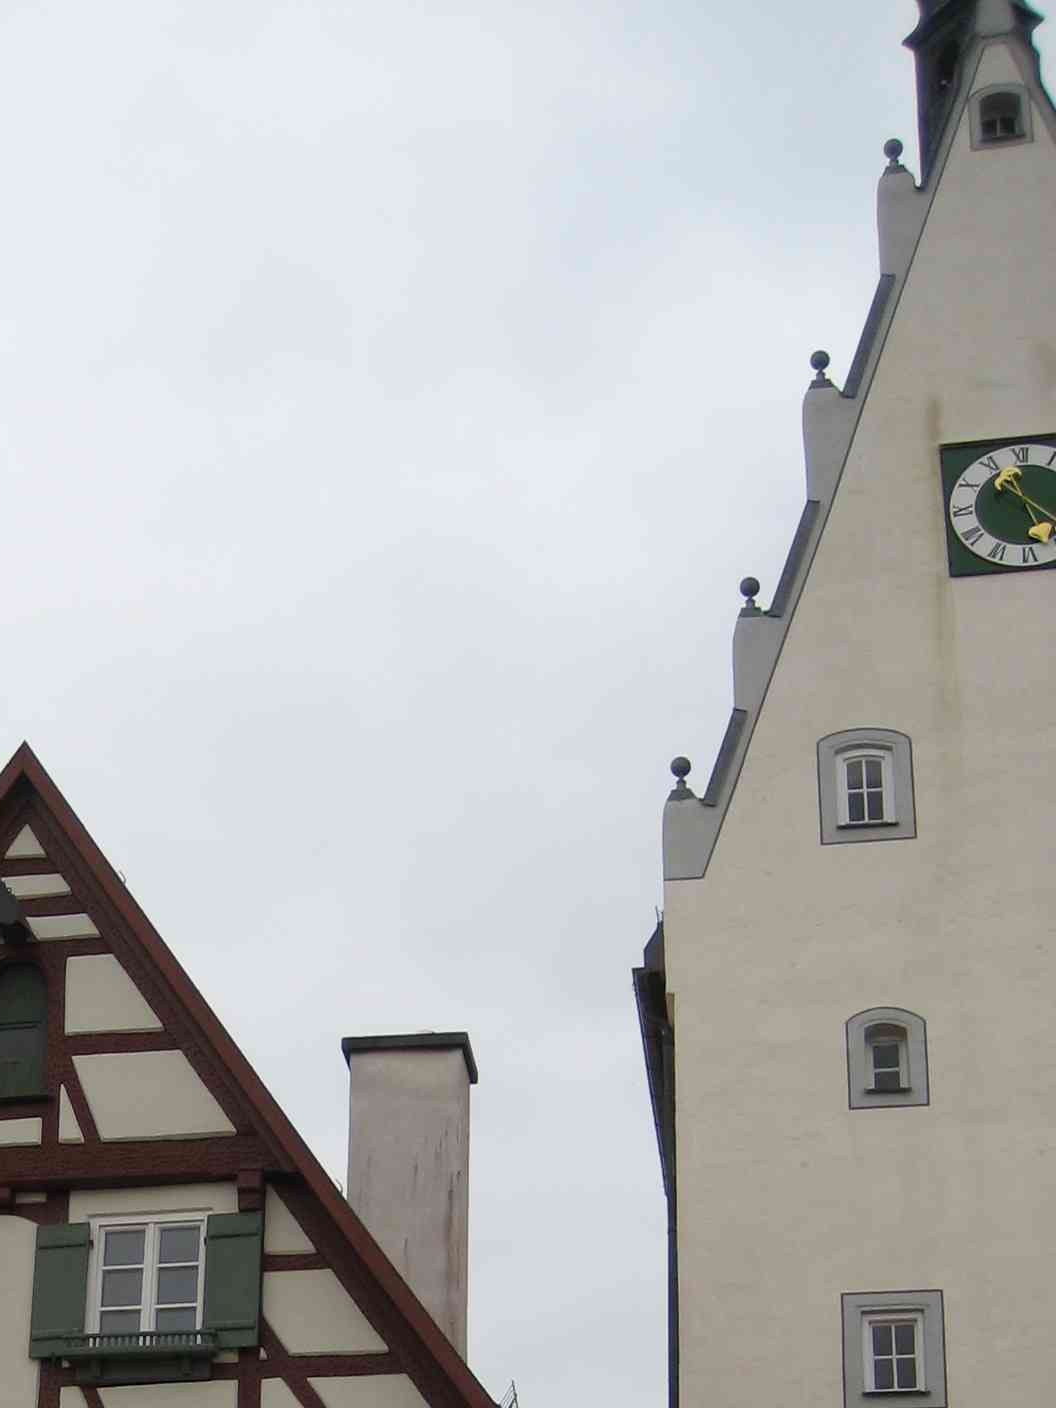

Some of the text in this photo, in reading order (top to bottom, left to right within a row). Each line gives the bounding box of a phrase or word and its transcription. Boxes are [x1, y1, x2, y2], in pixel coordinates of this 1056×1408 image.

[1009, 447, 1029, 464] XII
[979, 455, 1000, 475] XI
[958, 477, 980, 493] X
[953, 503, 973, 518] IX
[1022, 546, 1039, 564] VI
